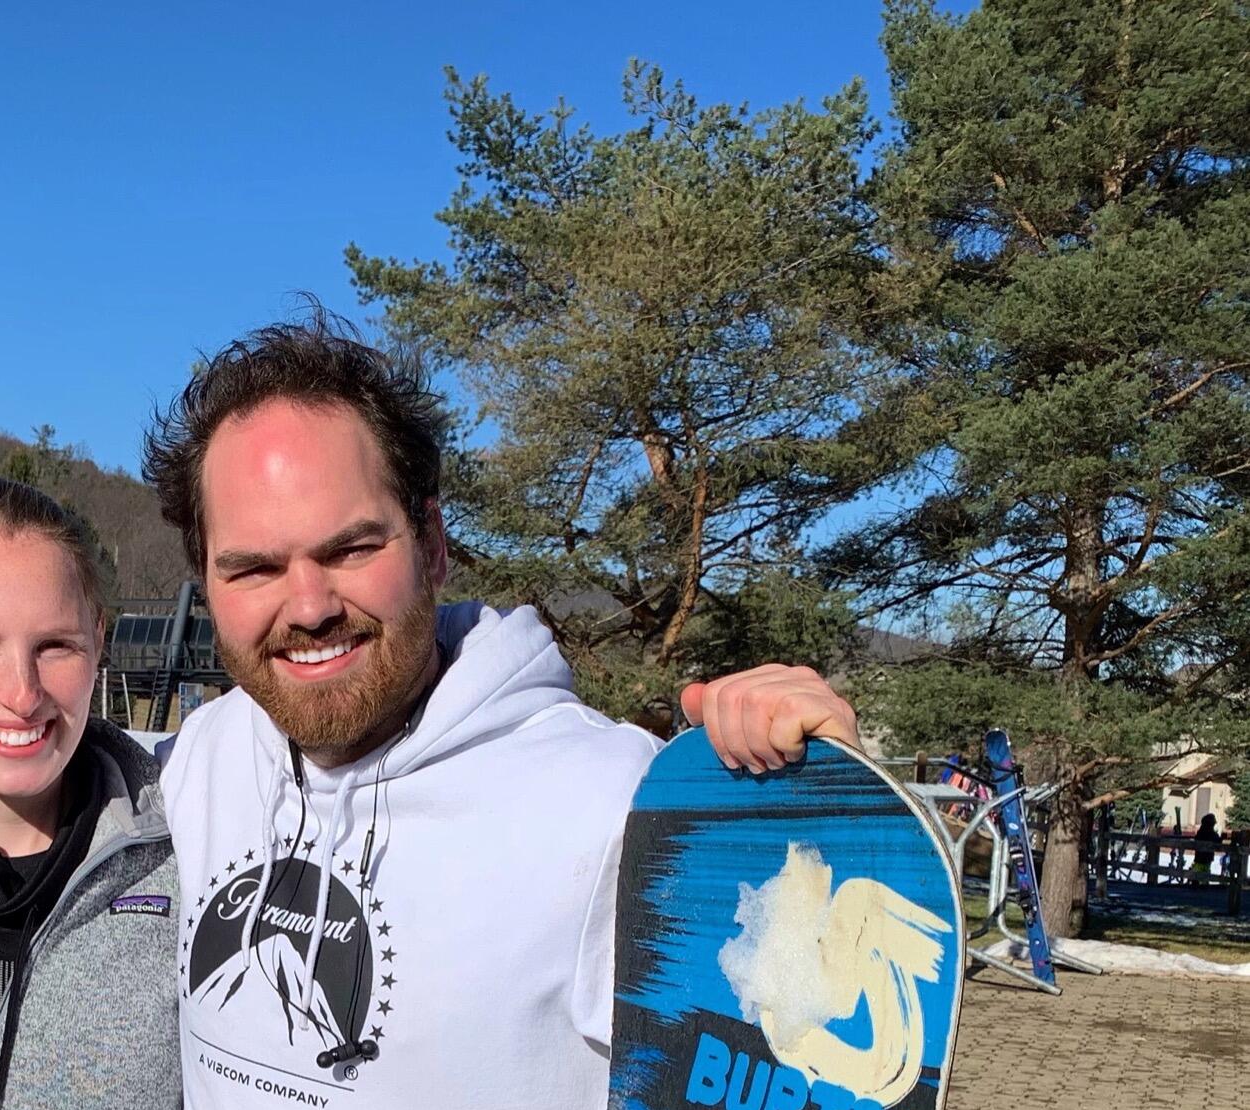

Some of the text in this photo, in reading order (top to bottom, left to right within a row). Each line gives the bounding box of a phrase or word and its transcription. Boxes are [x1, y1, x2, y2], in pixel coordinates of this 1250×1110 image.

[115, 904, 163, 913] patagonia
[199, 1054, 205, 1064] A
[255, 1078, 329, 1109] COMPANY
